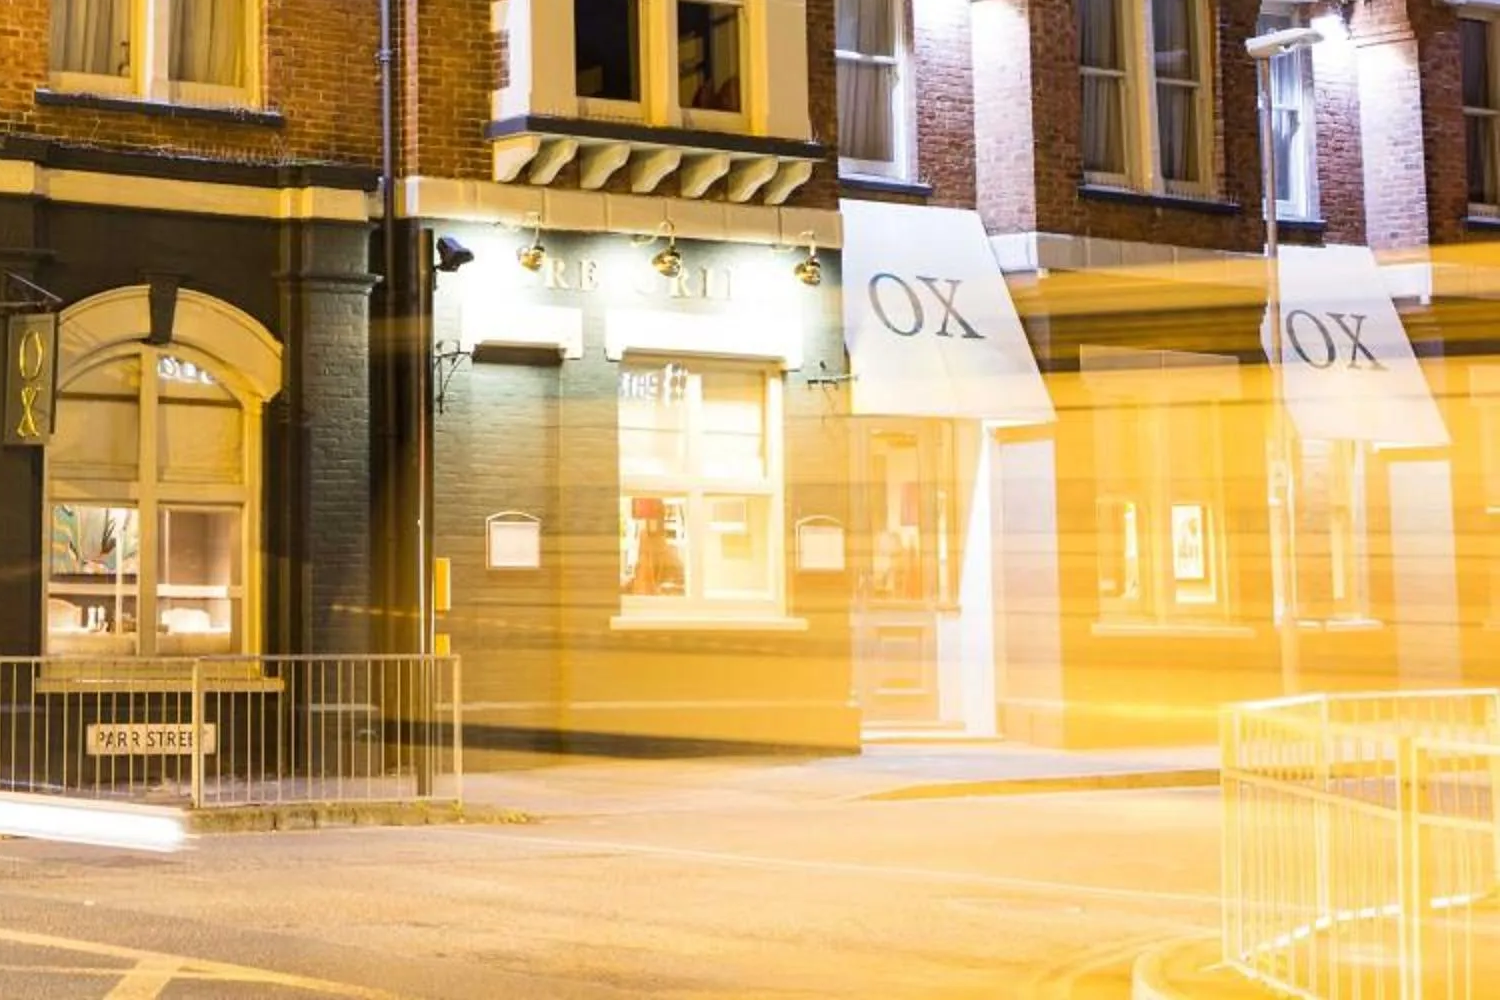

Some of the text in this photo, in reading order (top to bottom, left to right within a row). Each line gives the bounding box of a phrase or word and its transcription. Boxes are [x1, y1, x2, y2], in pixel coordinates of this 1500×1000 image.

[869, 272, 986, 340] OX
[1285, 309, 1388, 371] OX
[15, 330, 47, 437] OX
[97, 731, 207, 748] PARR STREE
